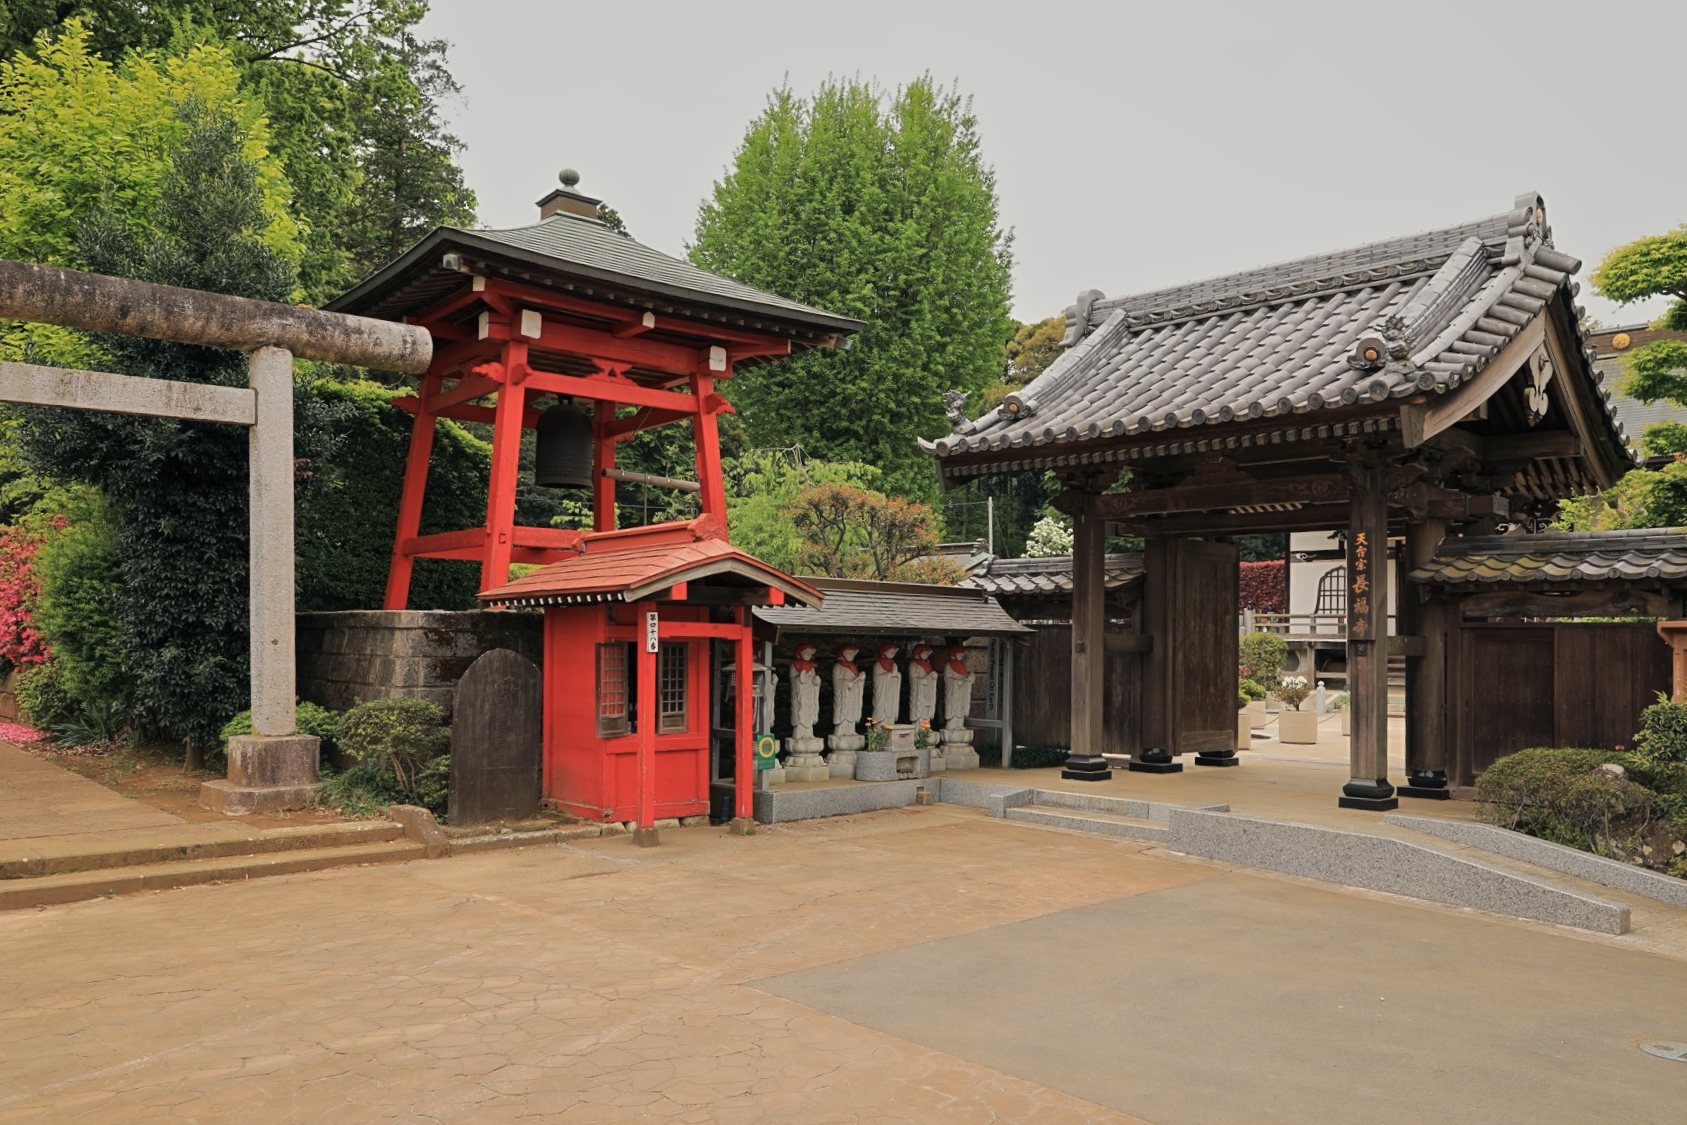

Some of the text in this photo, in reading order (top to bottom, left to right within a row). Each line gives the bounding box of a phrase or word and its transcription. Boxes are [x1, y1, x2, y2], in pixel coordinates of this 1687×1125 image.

[1352, 532, 1369, 637] 天台宗長福寺
[649, 614, 657, 650] 第四十八番
